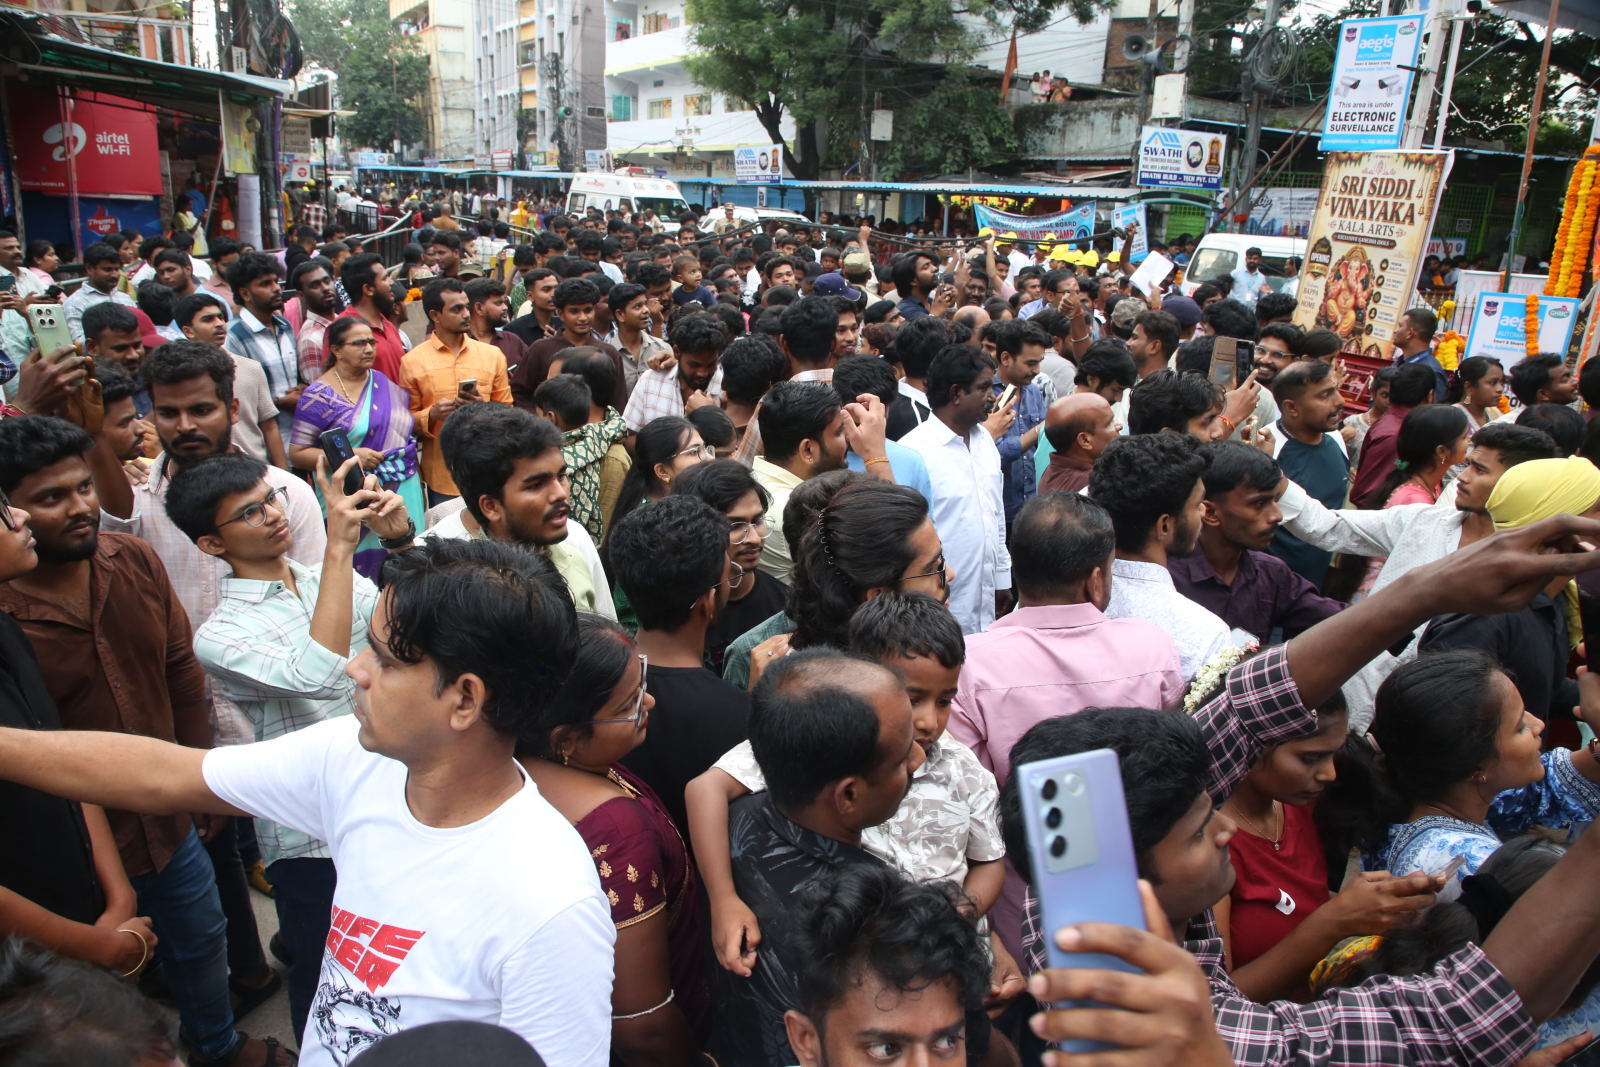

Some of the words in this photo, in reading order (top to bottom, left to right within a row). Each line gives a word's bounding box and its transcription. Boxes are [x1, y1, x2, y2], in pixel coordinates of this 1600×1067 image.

[1359, 33, 1394, 52] aegis
[1332, 111, 1397, 122] ELECTRONIC
[1329, 124, 1395, 133] SURVEILLANCE
[96, 131, 130, 145] airtel
[97, 144, 131, 156] Wi-Fi
[1143, 147, 1183, 158] SWATHI
[1339, 175, 1368, 197] SRI
[1367, 177, 1417, 200] SIDDI
[1329, 196, 1416, 226] VINAYAKA
[1338, 220, 1365, 234] KALA
[1367, 223, 1396, 237] ARTS
[325, 928, 401, 995] CER
